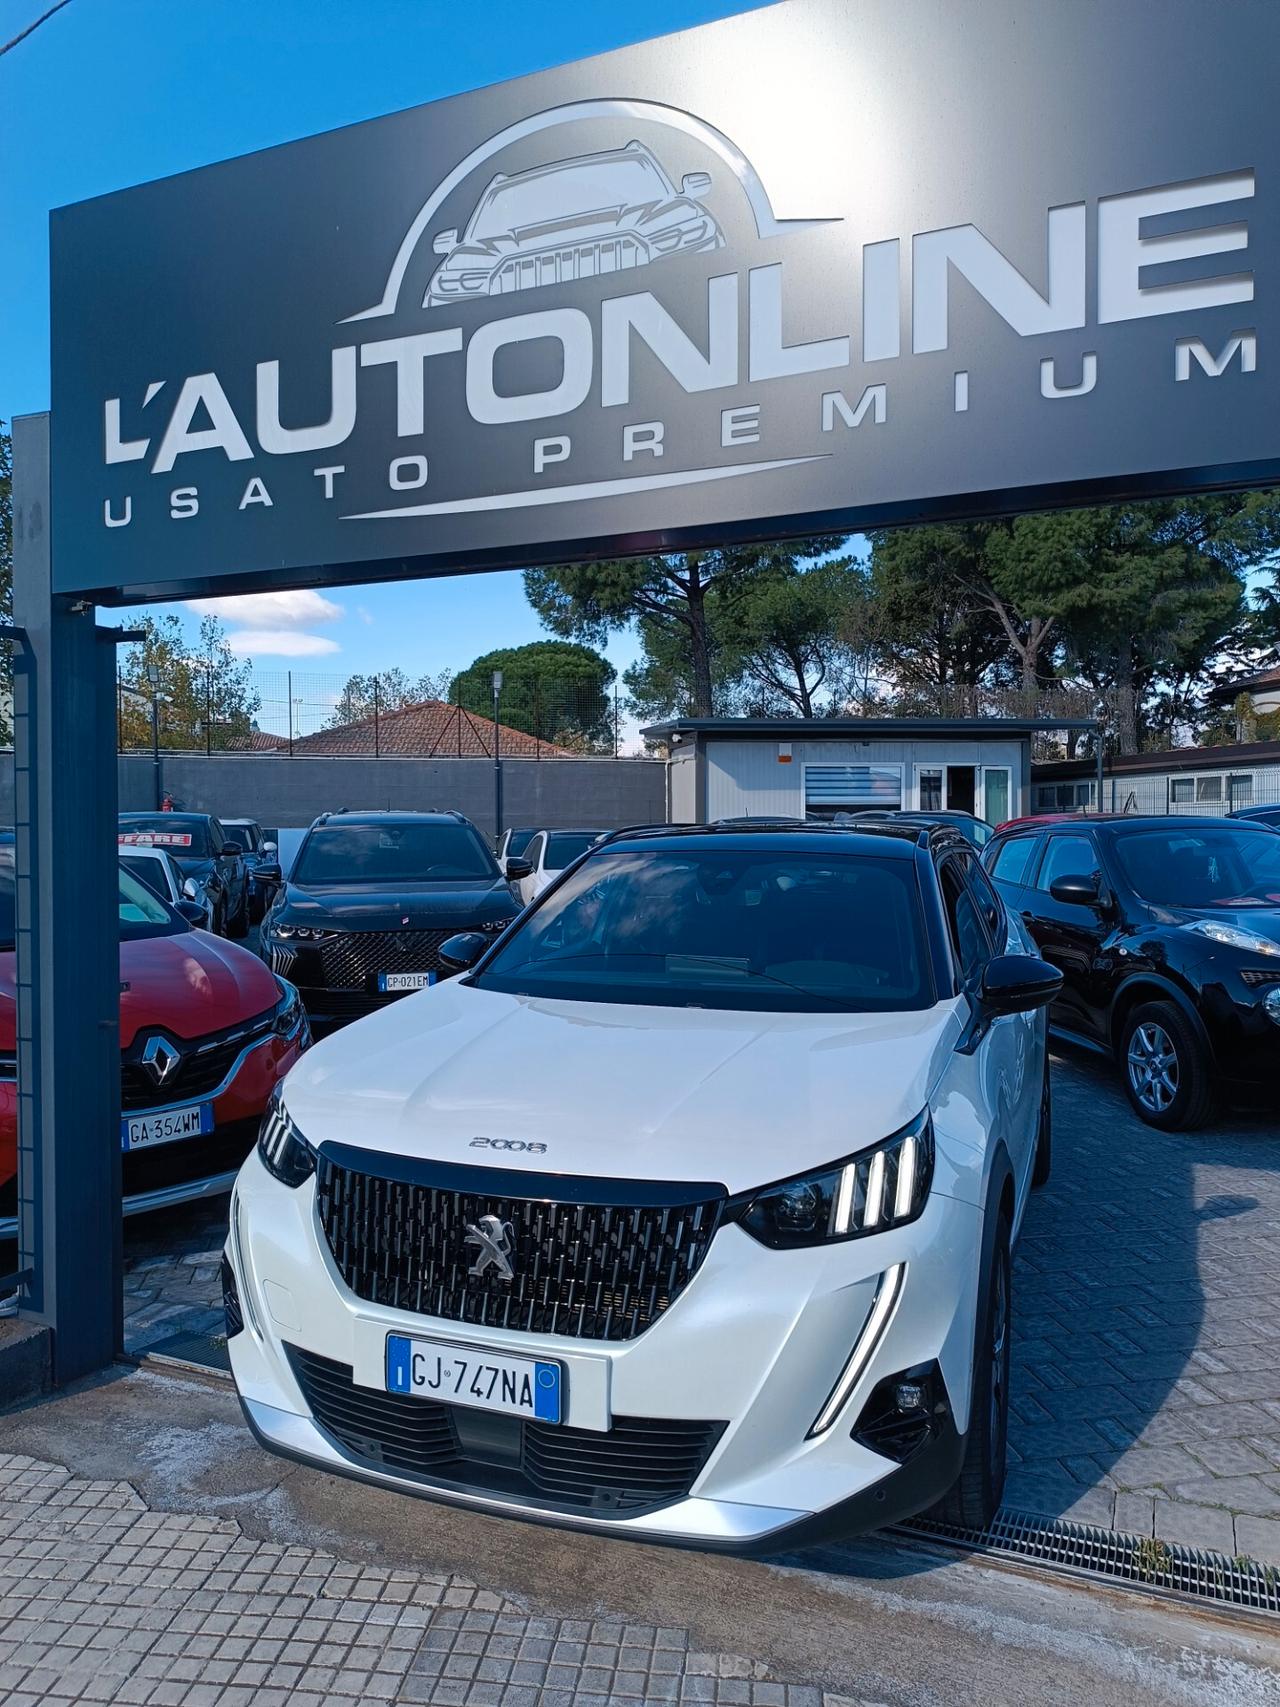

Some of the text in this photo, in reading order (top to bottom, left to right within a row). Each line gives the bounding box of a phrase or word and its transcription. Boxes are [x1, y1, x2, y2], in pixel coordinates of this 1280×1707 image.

[104, 328, 1256, 528] USATO PREMIUM
[468, 1136, 548, 1155] 2008
